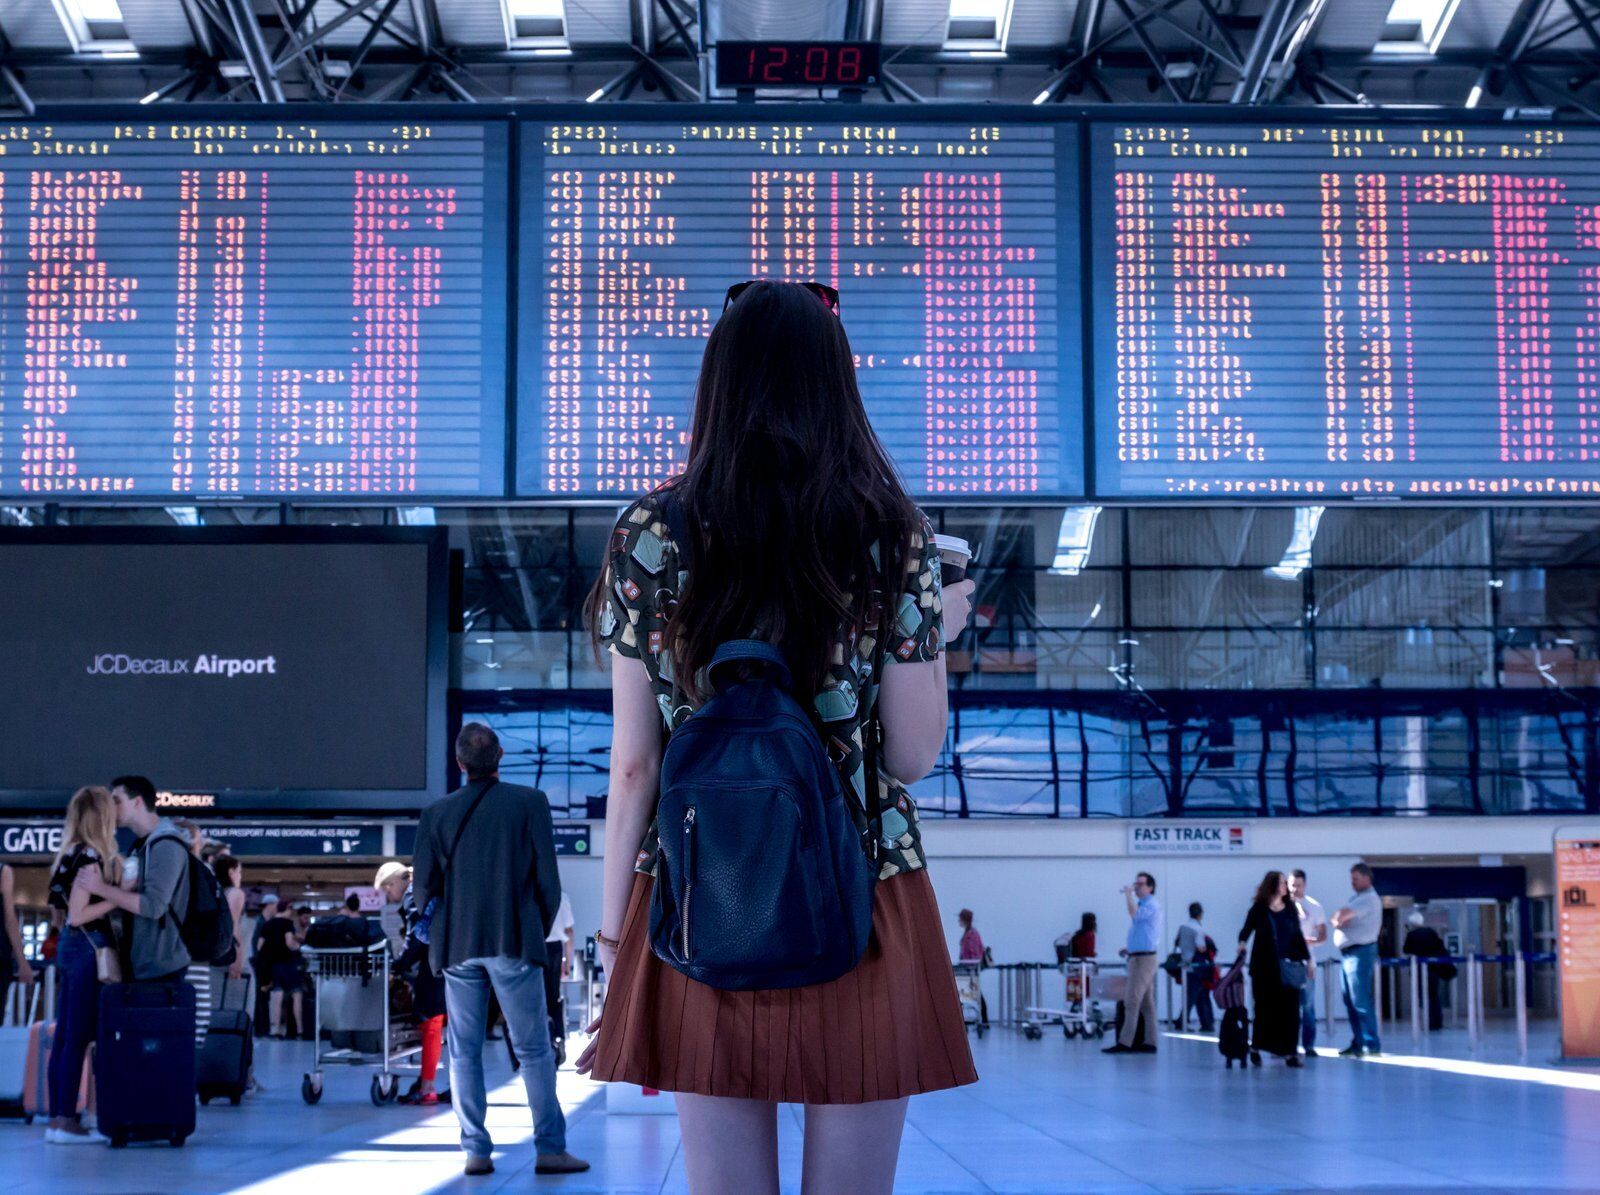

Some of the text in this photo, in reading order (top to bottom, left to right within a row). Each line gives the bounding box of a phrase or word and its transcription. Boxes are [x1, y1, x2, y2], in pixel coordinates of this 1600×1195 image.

[747, 47, 862, 82] 12:08
[87, 654, 276, 678] JCDecaux Airport
[155, 791, 216, 807] Decaux
[229, 828, 264, 837] PASSPORT
[265, 828, 281, 837] AND
[282, 828, 317, 837] BOARDING
[318, 828, 335, 837] PASS
[337, 828, 361, 837] READY
[1134, 827, 1222, 841] FAST TRACK
